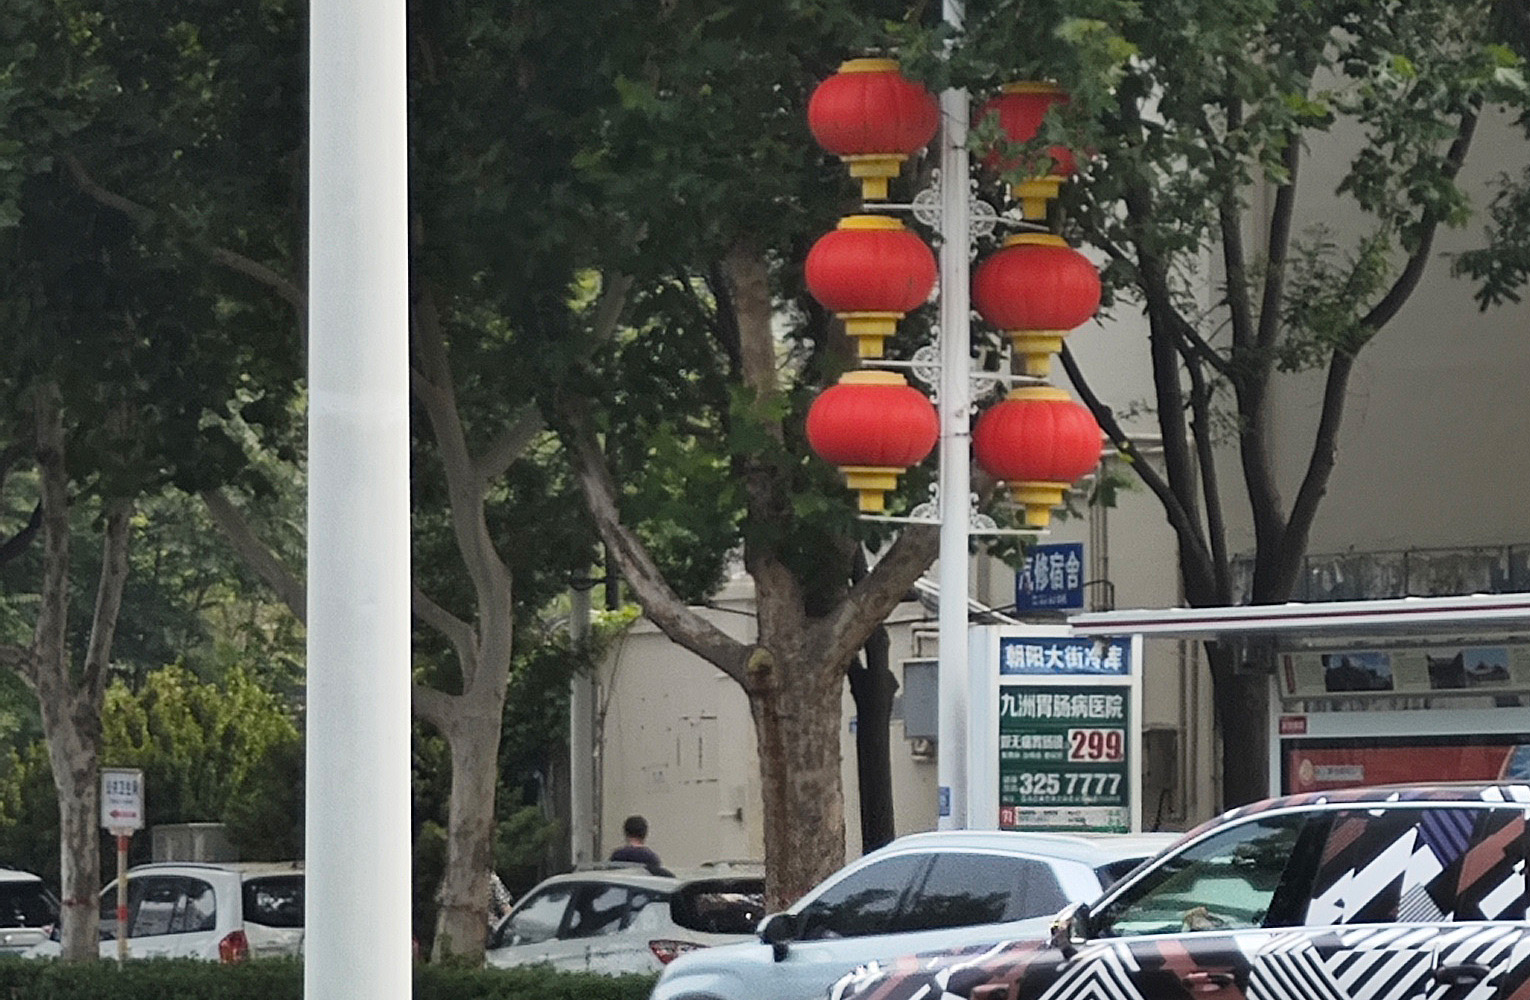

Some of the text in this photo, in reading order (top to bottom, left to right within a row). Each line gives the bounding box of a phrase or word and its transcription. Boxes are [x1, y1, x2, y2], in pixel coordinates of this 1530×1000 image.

[1004, 643, 1123, 670] 朝阳大街冷库
[1000, 692, 1124, 718] 九洲胃肠病医院
[1071, 730, 1122, 760] 299
